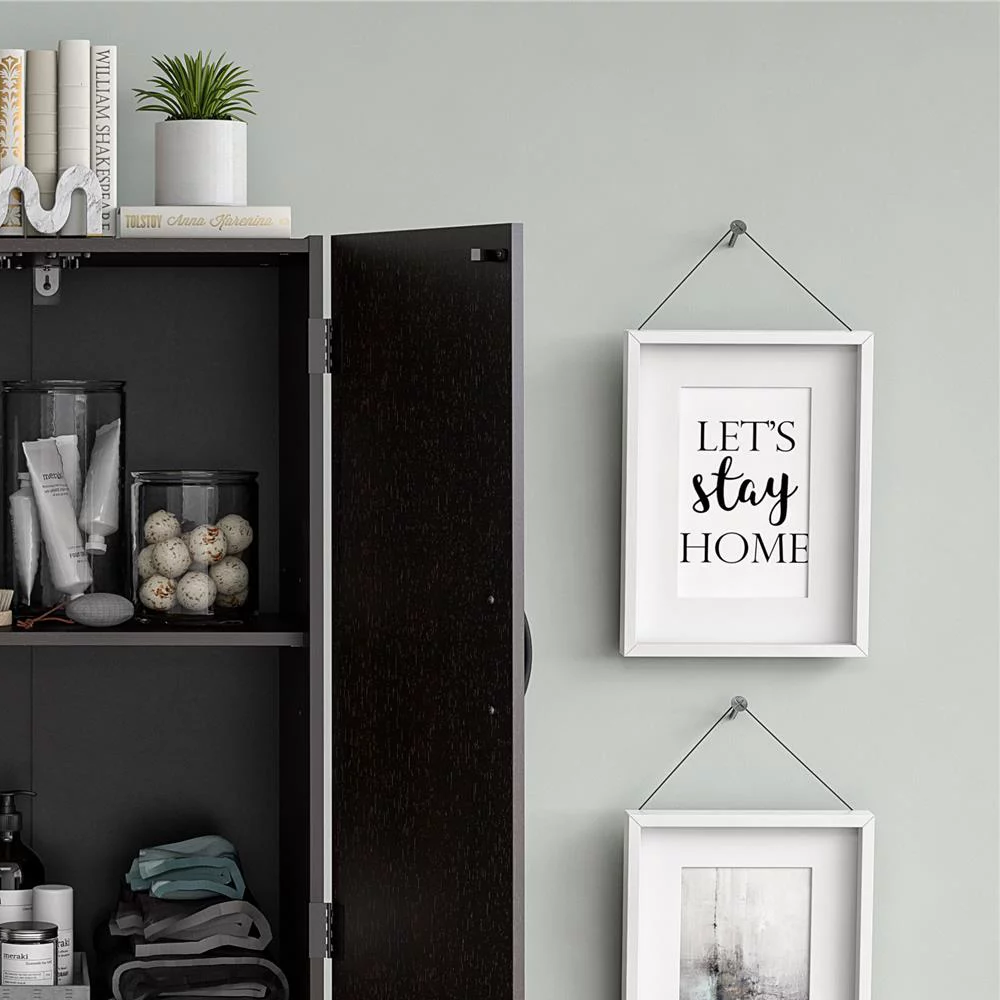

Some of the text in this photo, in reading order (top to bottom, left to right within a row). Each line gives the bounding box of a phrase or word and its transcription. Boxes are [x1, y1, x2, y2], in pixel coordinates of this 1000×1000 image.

[95, 49, 110, 120] WILLIAM
[126, 214, 273, 230] TOLSTOY Anna Karenina
[697, 420, 796, 452] LET'S
[692, 456, 798, 526] stay
[680, 532, 808, 564] HOME
